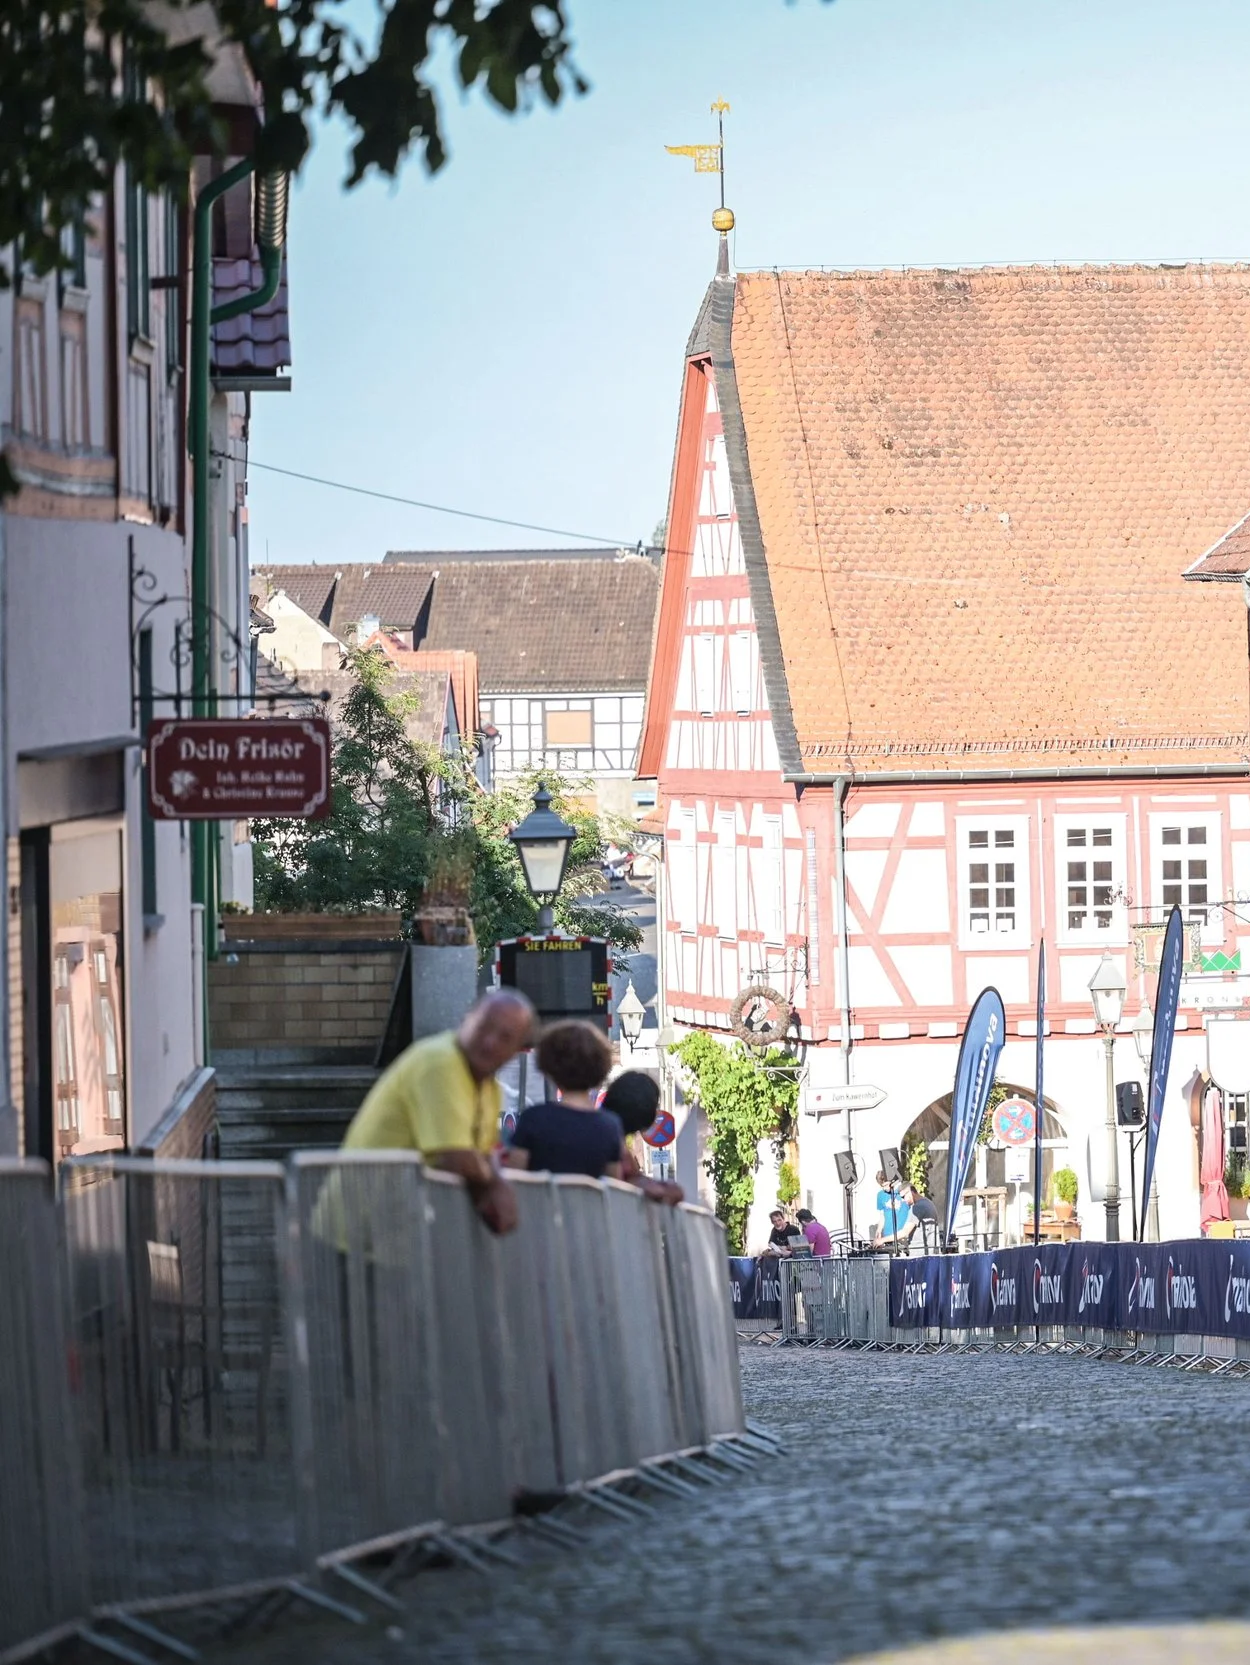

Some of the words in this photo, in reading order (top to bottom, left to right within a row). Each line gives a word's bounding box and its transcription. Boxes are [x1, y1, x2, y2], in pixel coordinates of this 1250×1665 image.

[179, 736, 230, 763] Dein
[524, 941, 541, 952] SIE
[543, 941, 582, 951] FAHREN
[591, 982, 608, 992] km
